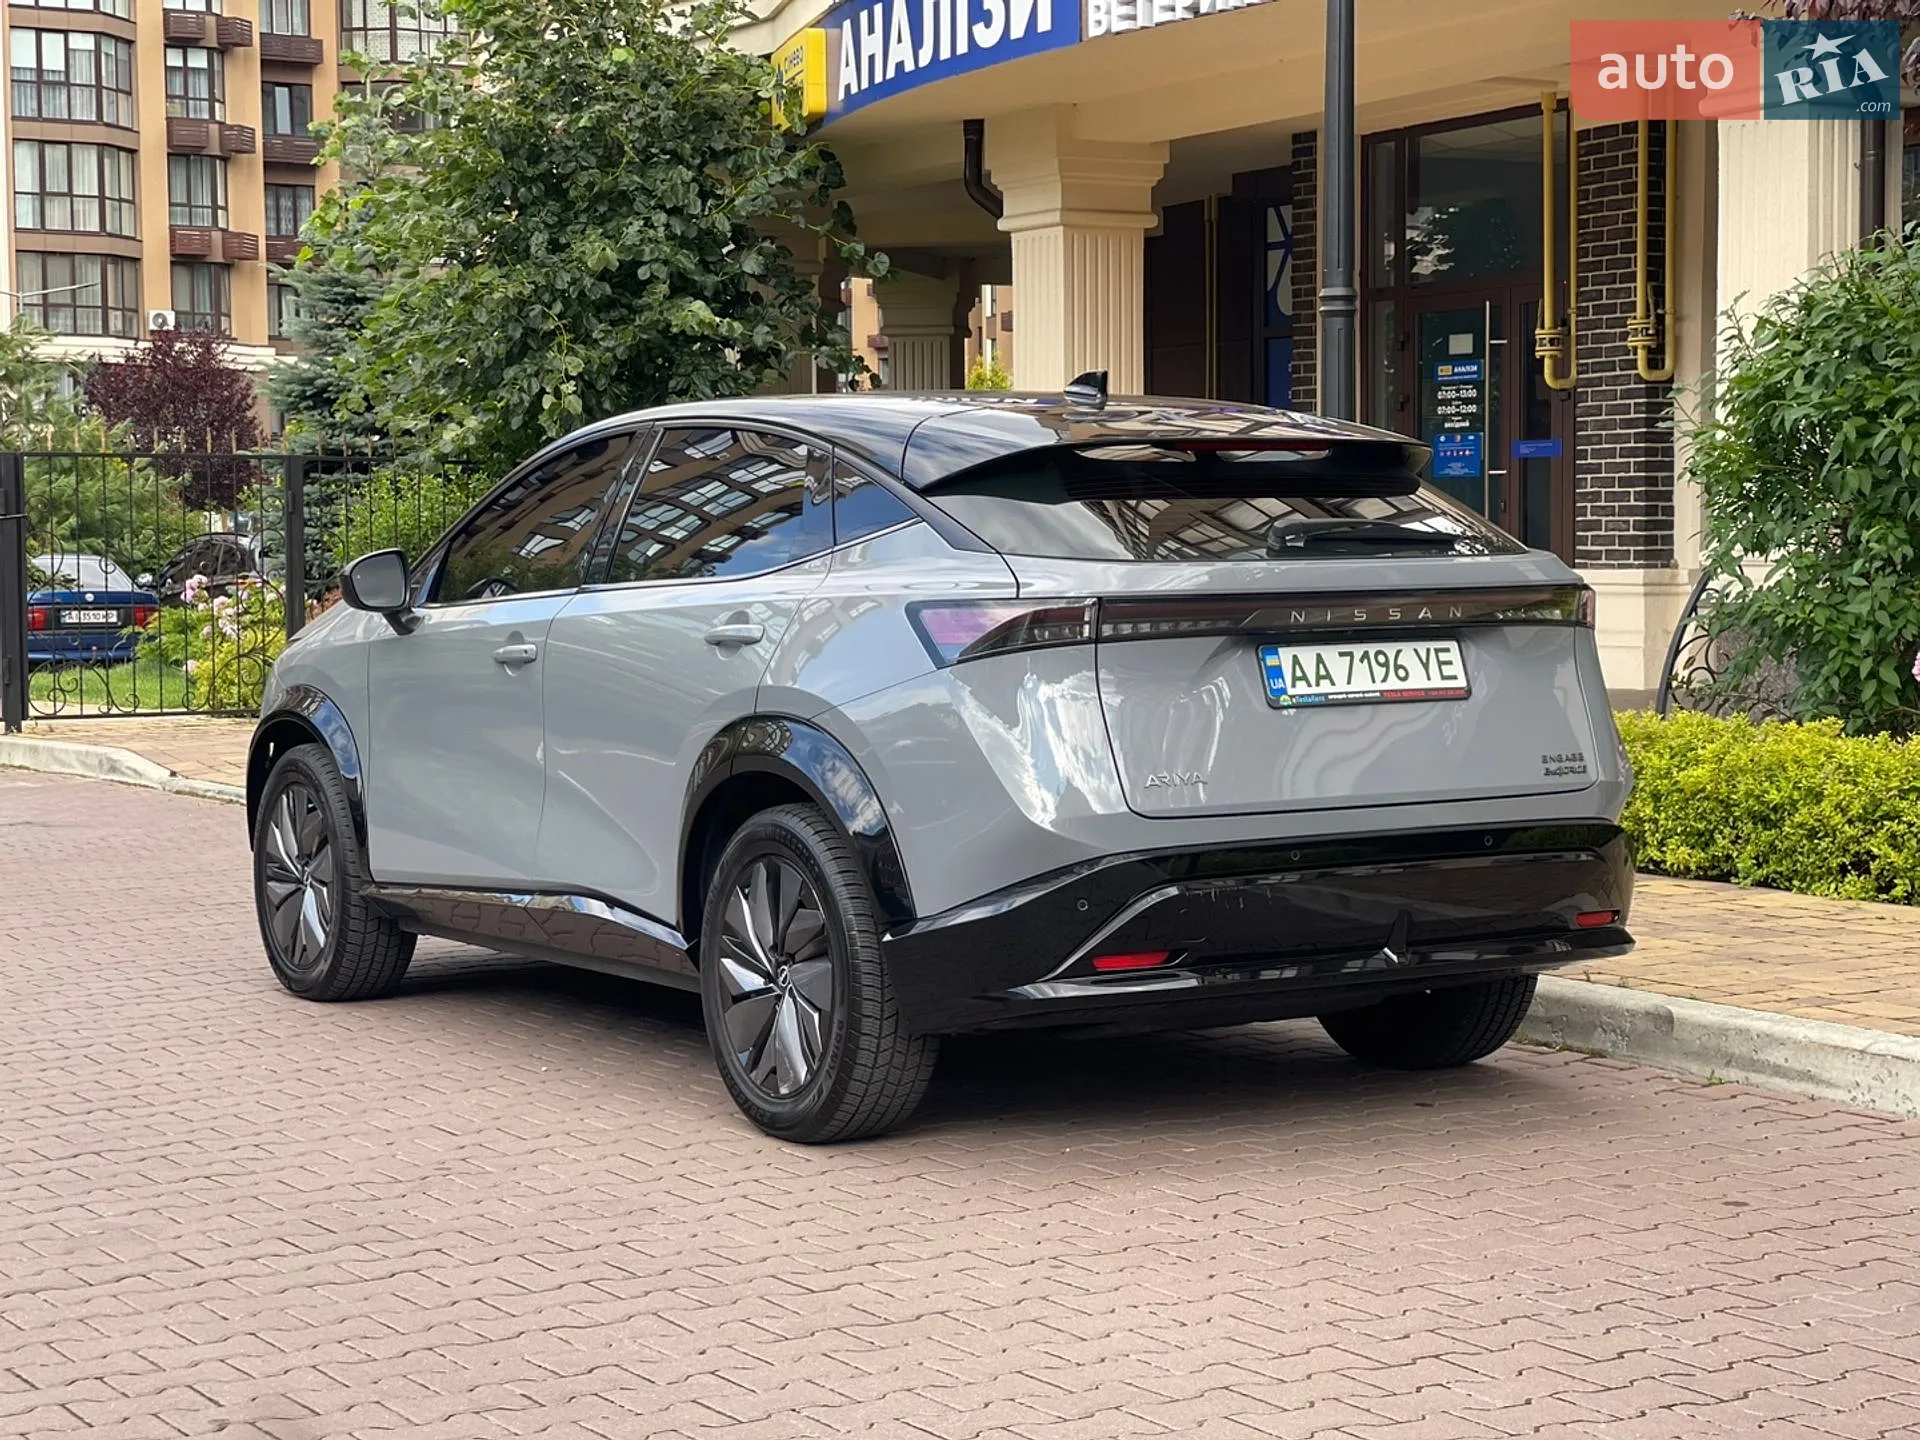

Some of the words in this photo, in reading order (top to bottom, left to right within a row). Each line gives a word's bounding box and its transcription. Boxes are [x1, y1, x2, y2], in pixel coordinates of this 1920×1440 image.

[1289, 605, 1463, 624] NISSAN
[1290, 653, 1336, 688] AA
[1338, 649, 1410, 685] 7196
[1413, 647, 1459, 681] YE
[1270, 678, 1285, 689] UA
[1144, 771, 1208, 788] ARIYA
